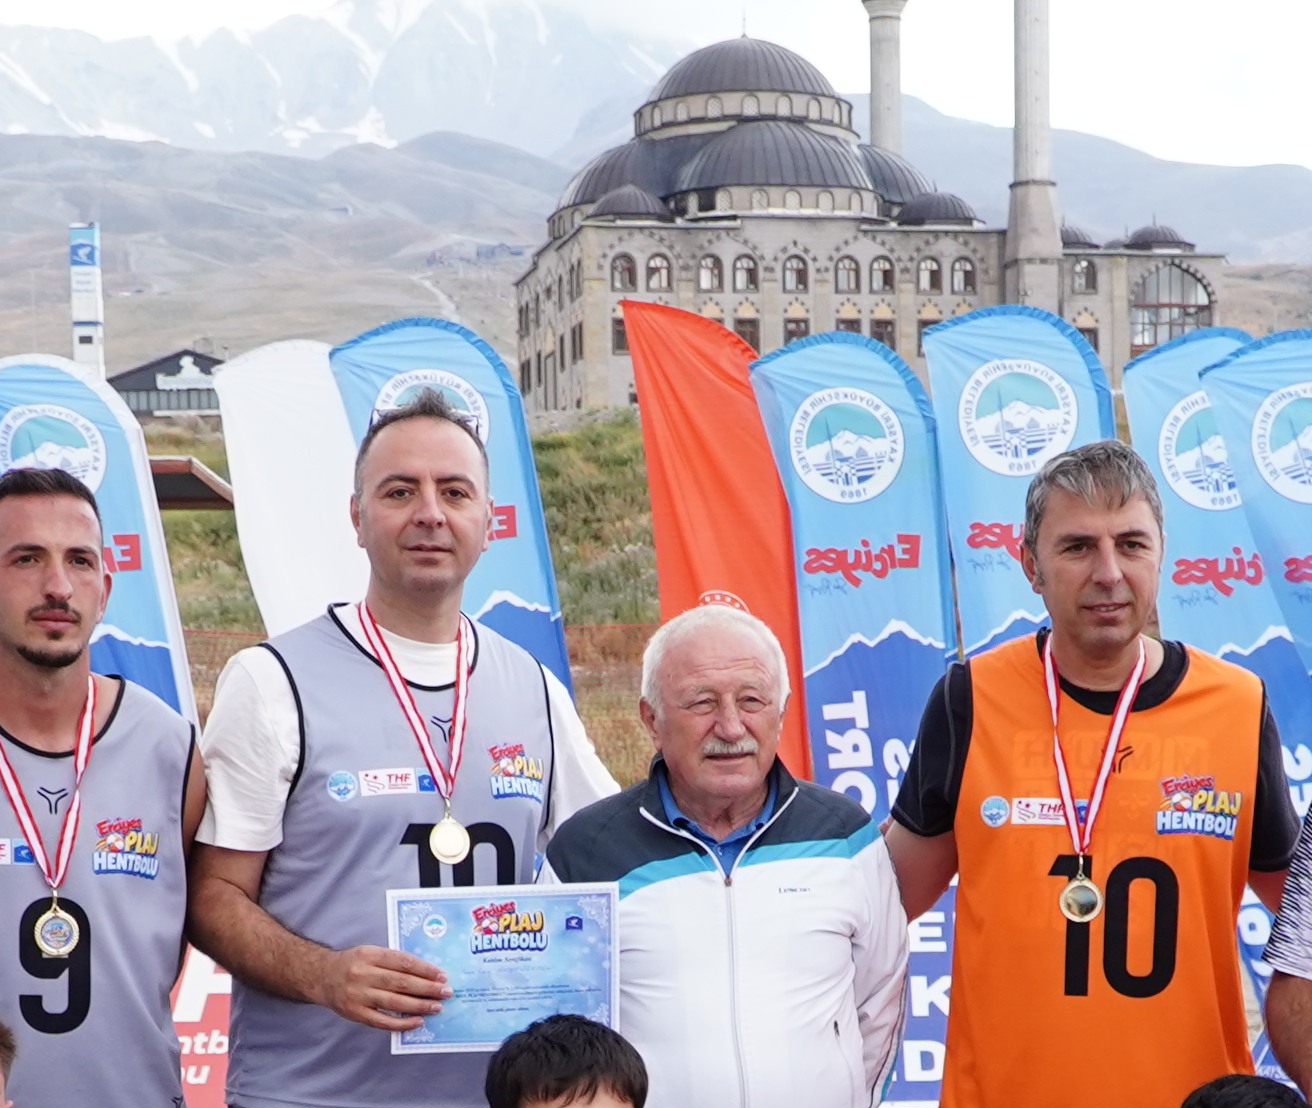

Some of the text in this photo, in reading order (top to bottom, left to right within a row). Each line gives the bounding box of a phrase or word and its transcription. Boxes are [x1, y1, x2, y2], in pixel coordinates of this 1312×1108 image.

[387, 774, 412, 784] THF
[1192, 789, 1242, 816] PLAJ
[125, 832, 160, 856] PLAJ
[498, 911, 545, 932] PLAJ
[1048, 854, 1180, 998] 10
[470, 932, 548, 954] HENTBOLU
[19, 897, 92, 1034] 9
